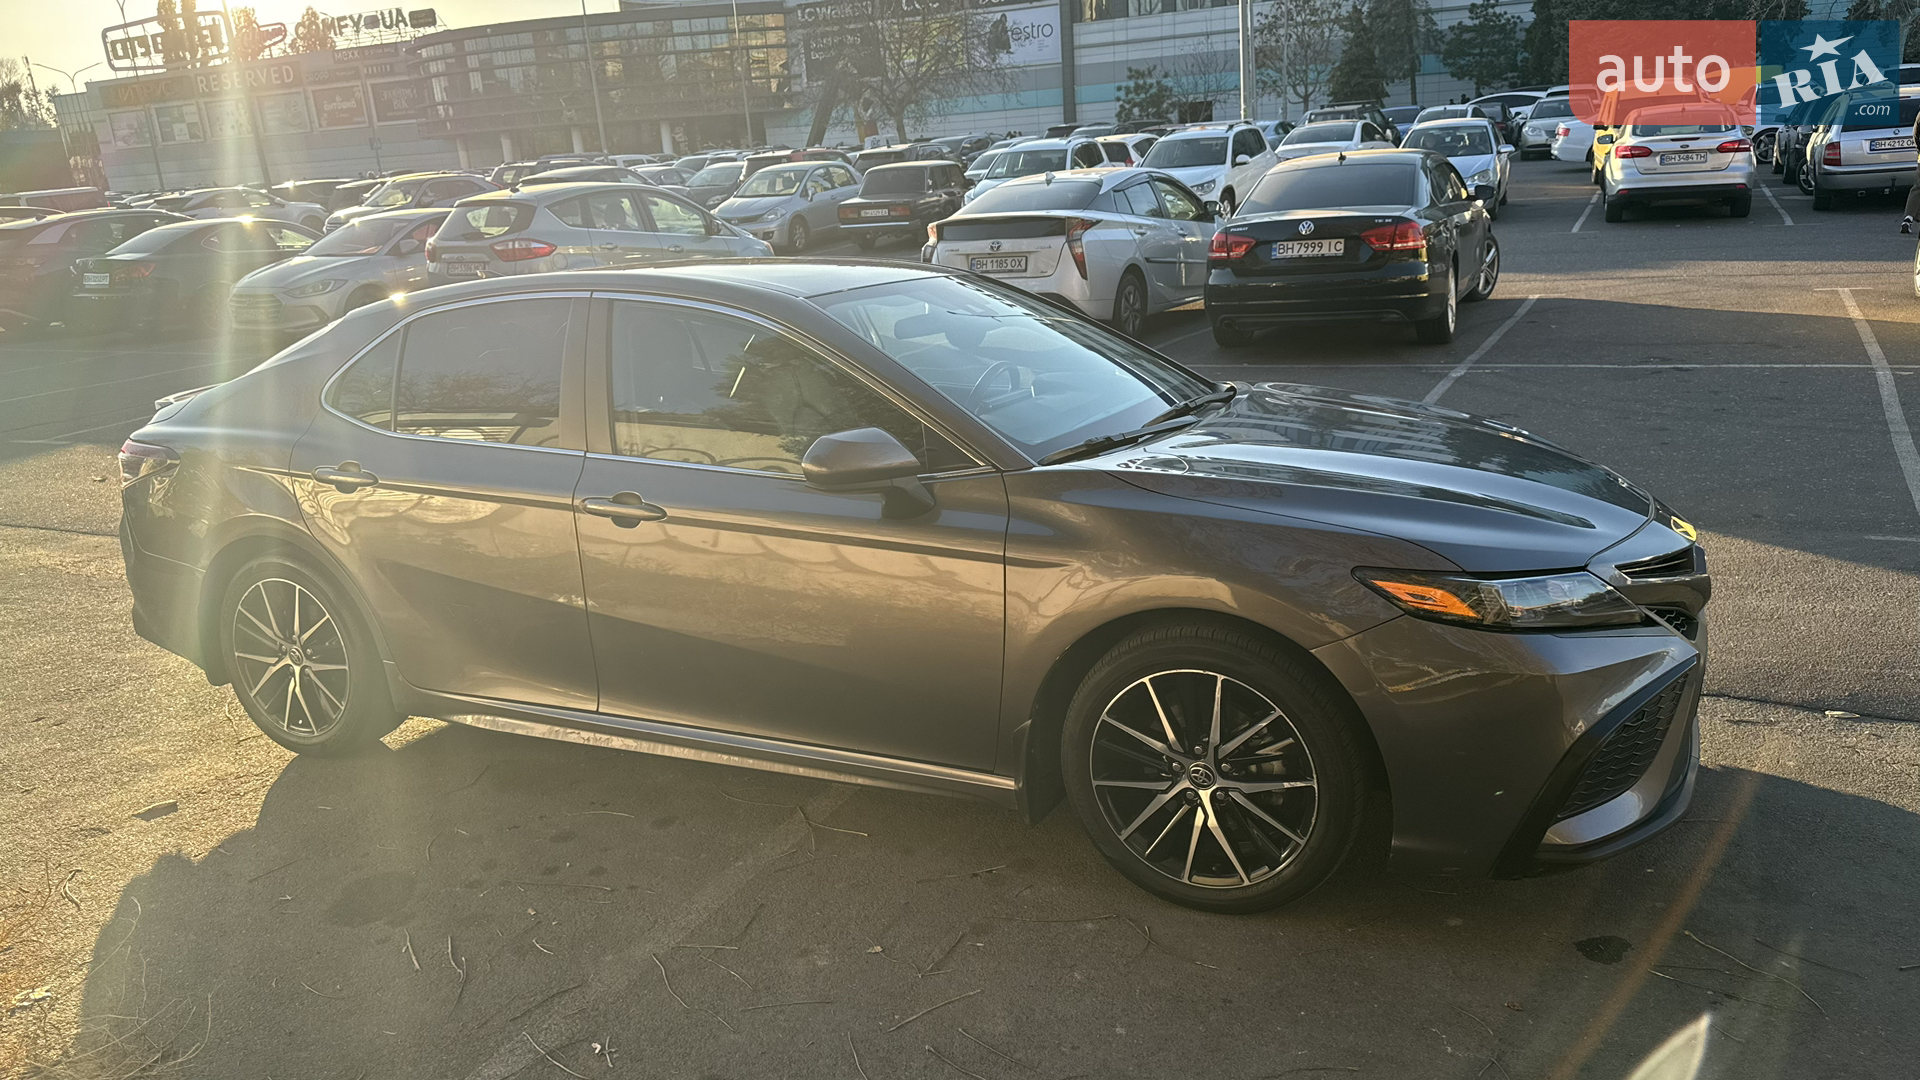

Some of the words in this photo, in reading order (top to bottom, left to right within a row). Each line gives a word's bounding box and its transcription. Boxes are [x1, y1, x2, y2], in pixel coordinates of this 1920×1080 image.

[1011, 22, 1054, 42] estro
[196, 64, 295, 94] RESERVED
[1665, 155, 1677, 163] BH
[1677, 154, 1694, 162] 3484
[1277, 243, 1295, 255] BH
[1298, 241, 1323, 254] 7999
[1328, 241, 1343, 252] IC
[976, 259, 988, 269] BH
[990, 259, 1009, 269] 1185
[1010, 258, 1023, 268] OX
